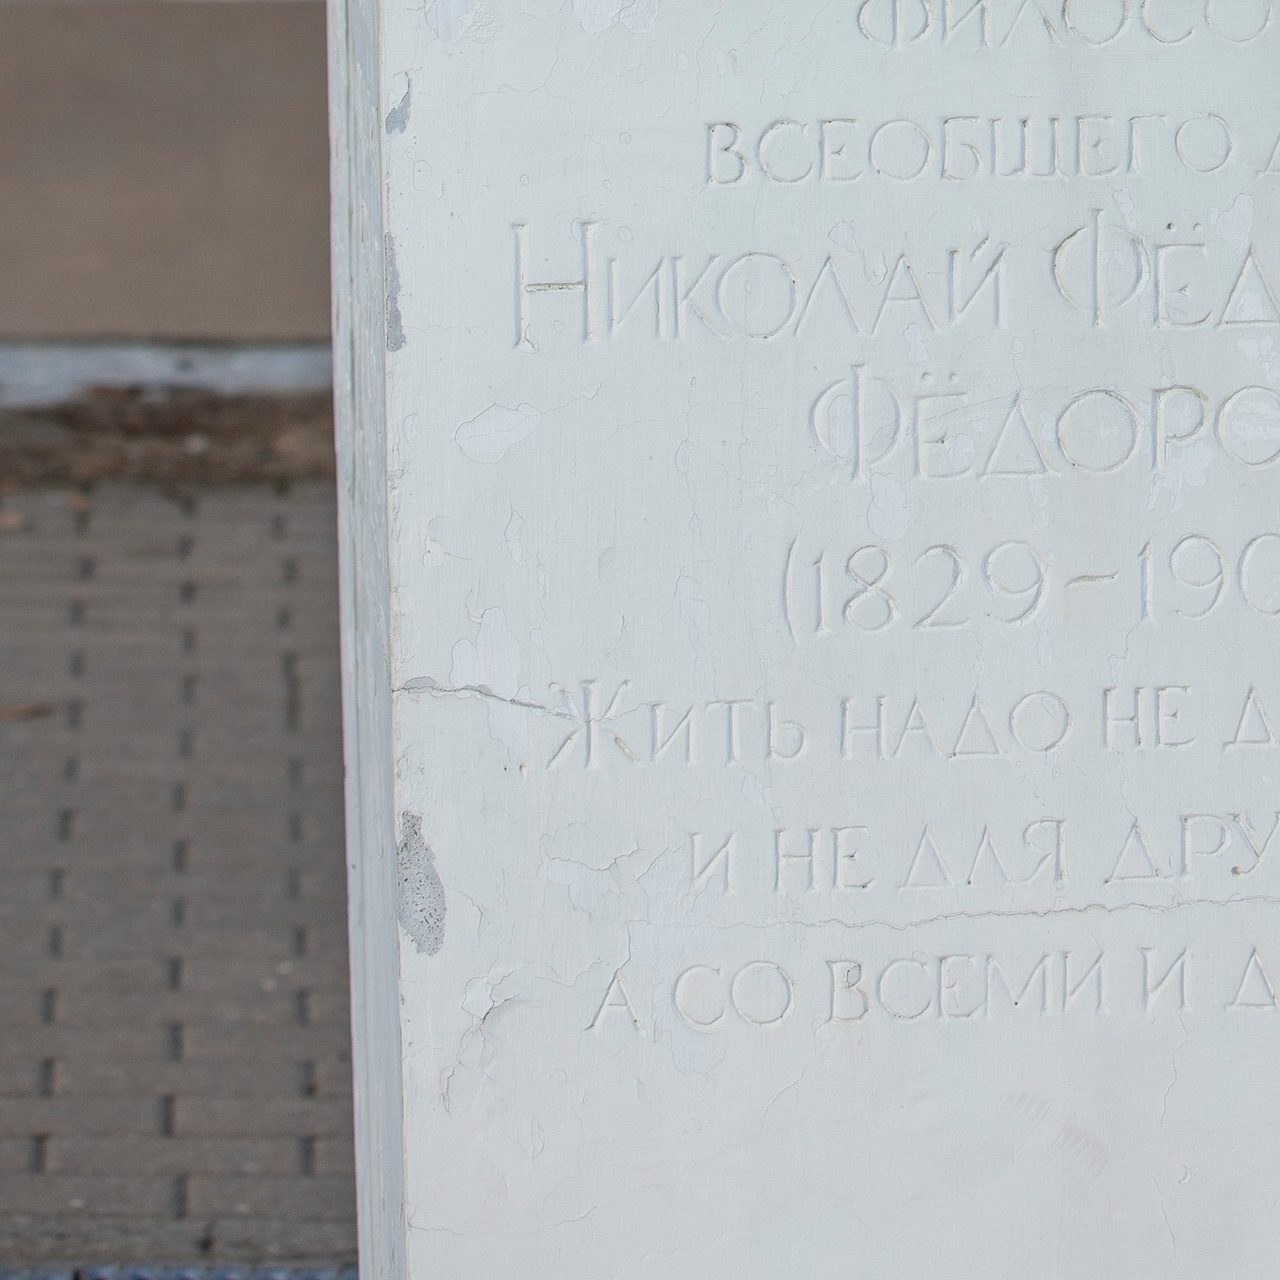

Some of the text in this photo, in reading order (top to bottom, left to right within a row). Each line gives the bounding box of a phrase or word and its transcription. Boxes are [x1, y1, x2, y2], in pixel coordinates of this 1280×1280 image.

[706, 113, 1234, 186] ВСЕОБЩЕГО
[511, 219, 1009, 348] НИКОЛАЙ
[546, 676, 810, 772] ЖИТЬ
[839, 684, 1074, 762] НАДО
[1099, 683, 1198, 752] НЕ
[684, 828, 739, 897] И
[772, 824, 877, 896] НЕ
[896, 816, 1068, 892] ДЛЯ
[583, 964, 651, 1038] А
[671, 959, 798, 1033] СО
[824, 946, 1114, 1028] ВСЕМИ
[1141, 946, 1195, 1014] И
